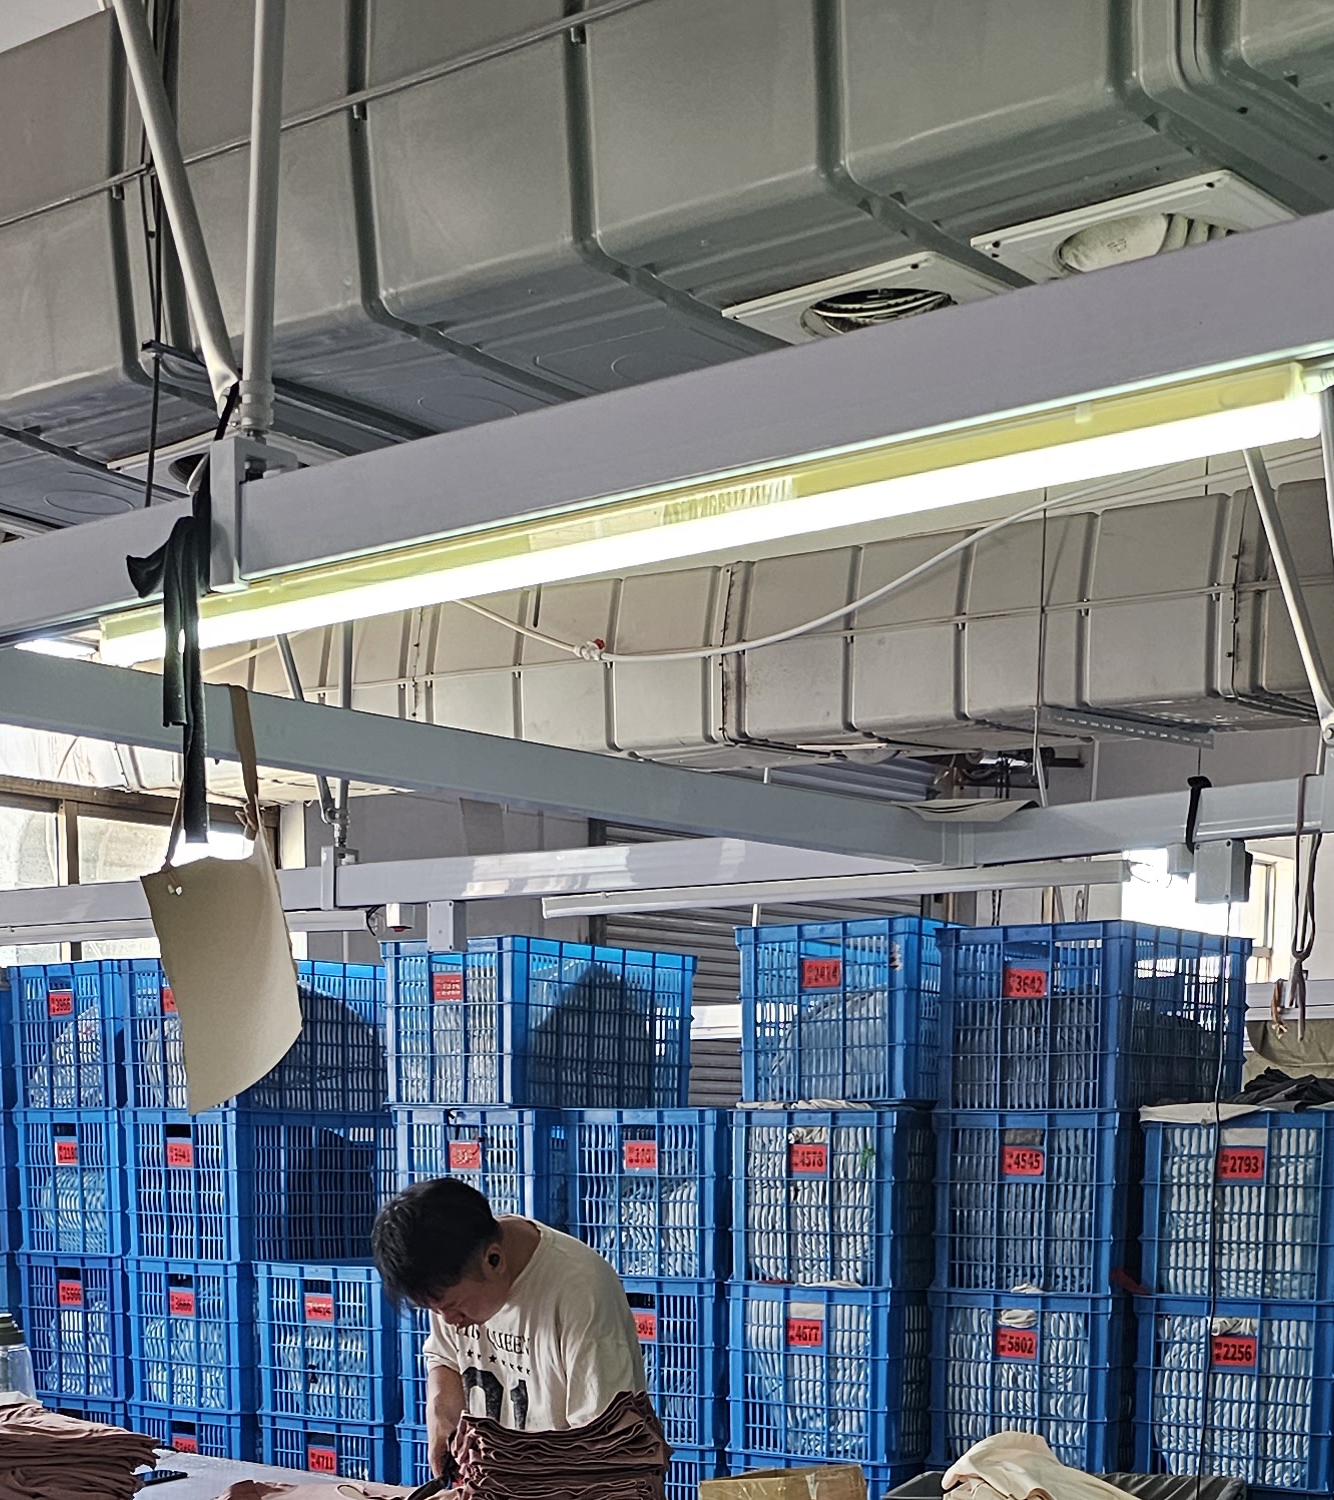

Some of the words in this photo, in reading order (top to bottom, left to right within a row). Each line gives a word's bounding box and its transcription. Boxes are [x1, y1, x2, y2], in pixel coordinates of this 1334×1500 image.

[1230, 1156, 1259, 1173] 2793
[1008, 1336, 1034, 1354] 5802
[1223, 1344, 1252, 1362] 2256
